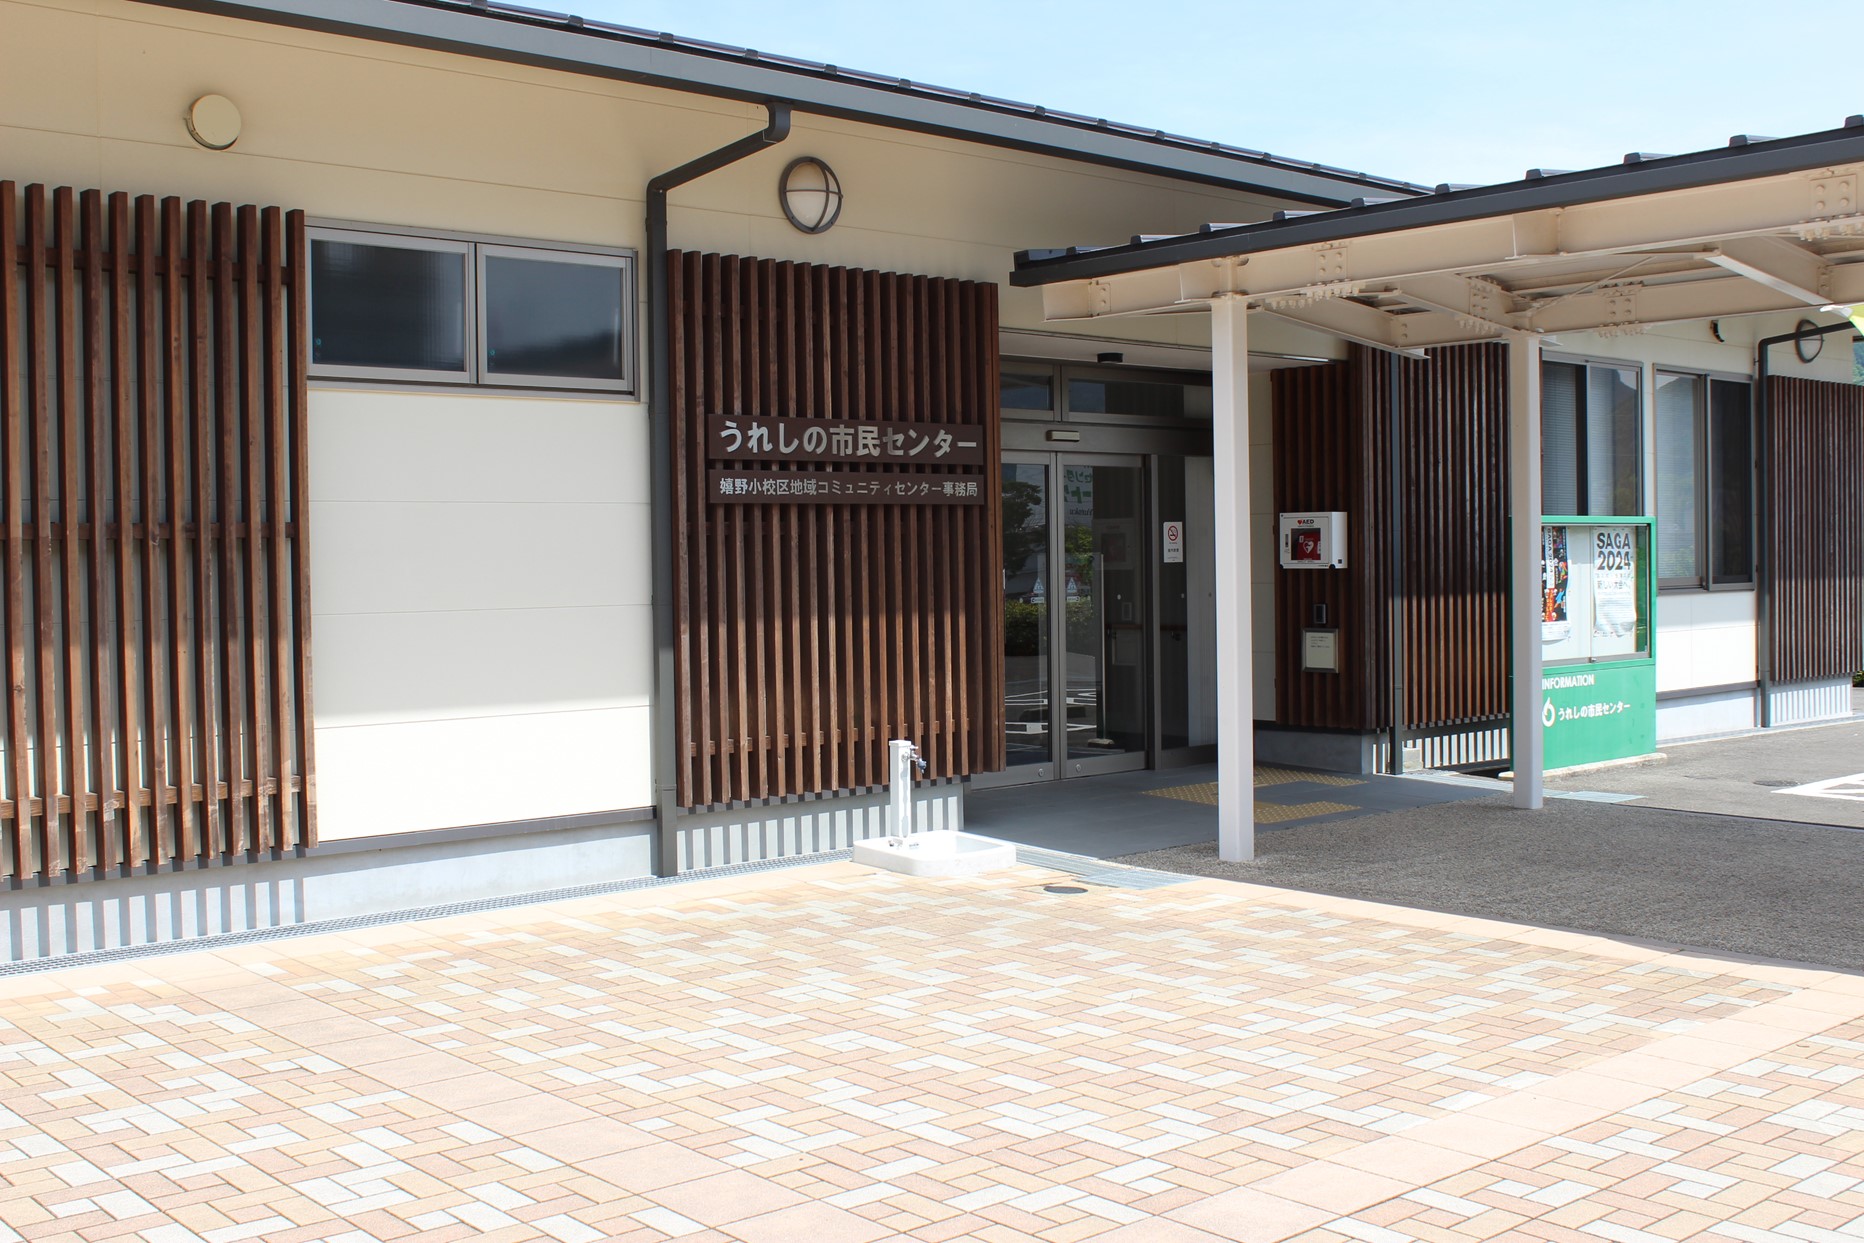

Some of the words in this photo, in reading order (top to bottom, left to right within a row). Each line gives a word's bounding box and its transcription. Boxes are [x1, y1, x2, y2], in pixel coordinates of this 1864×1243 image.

[719, 420, 977, 458] うれしの市民センター
[719, 477, 978, 497] 嬉野小校区地域コミュニティセンター事務局
[1596, 532, 1631, 549] SAGA
[1597, 551, 1631, 571] 2024
[1542, 674, 1595, 690] INFORMATION
[1558, 701, 1631, 721] うれしの市民センター
